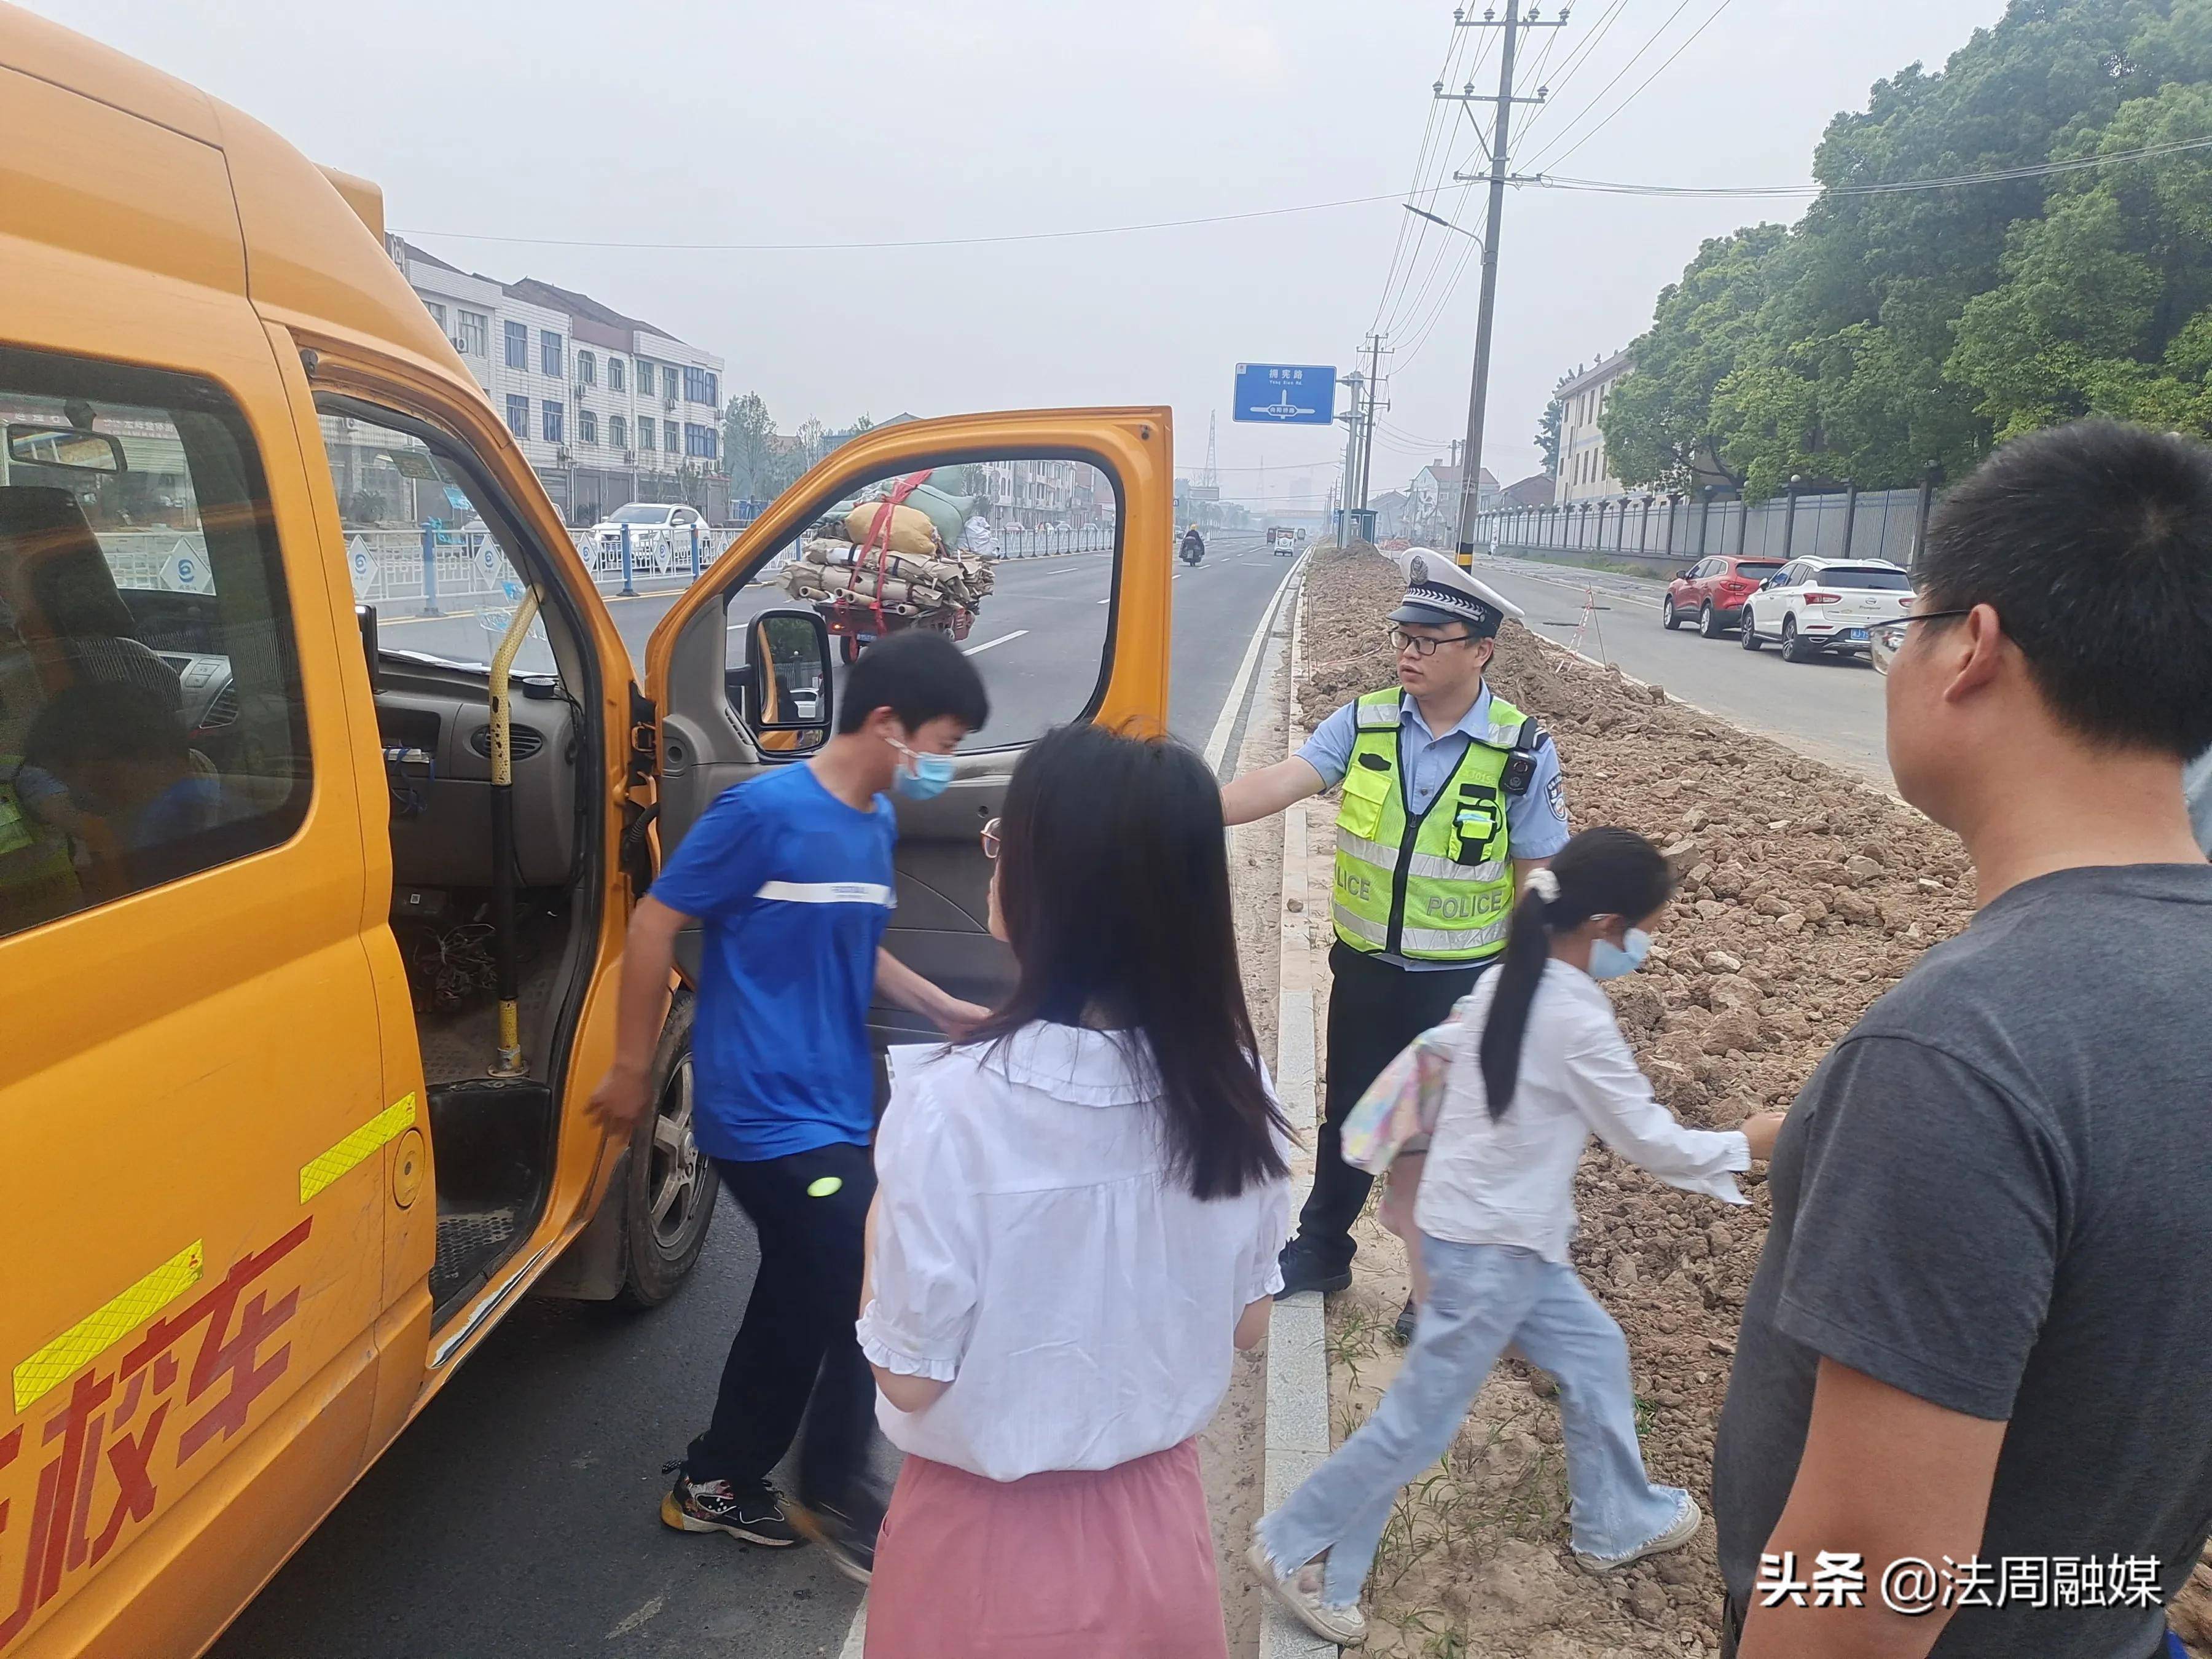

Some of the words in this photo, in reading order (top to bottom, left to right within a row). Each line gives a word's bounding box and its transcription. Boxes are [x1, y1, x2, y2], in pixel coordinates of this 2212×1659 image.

[1335, 865, 1371, 901] LICE
[1427, 890, 1502, 919] POLICE
[0, 1214, 313, 1649] 校车
